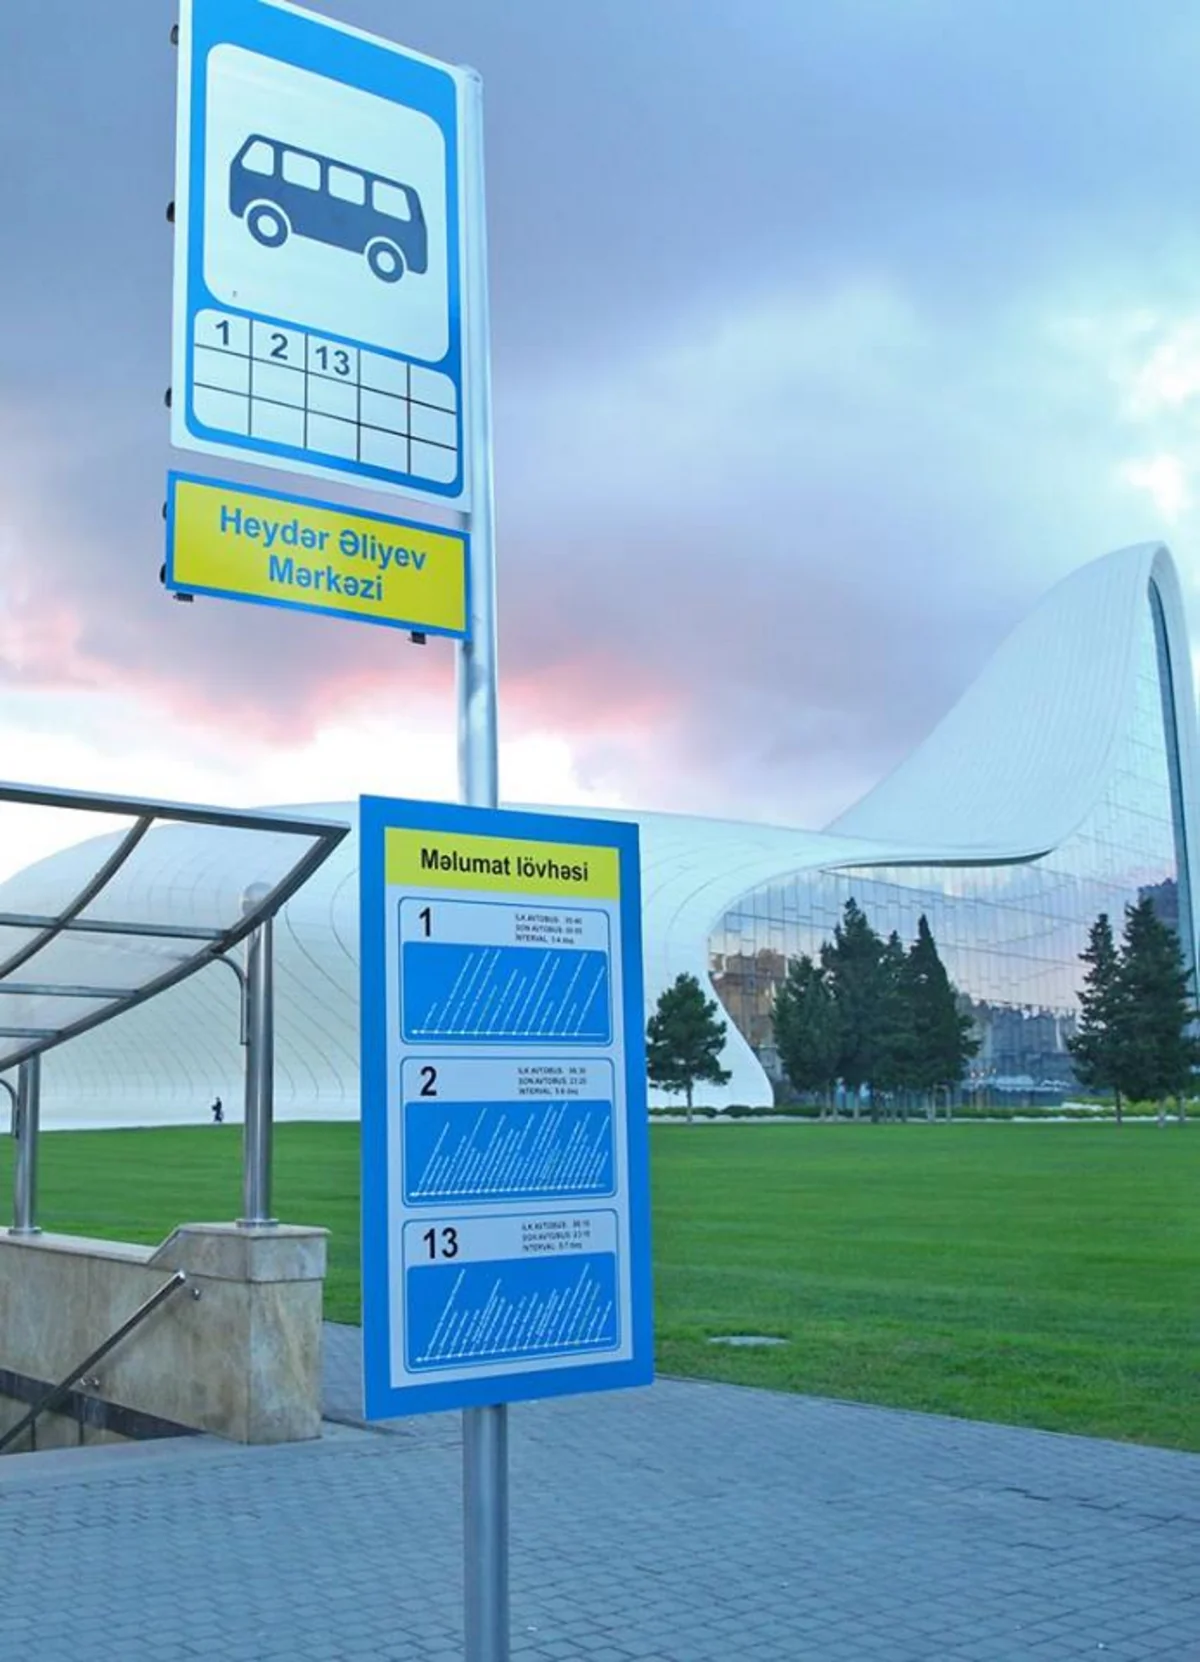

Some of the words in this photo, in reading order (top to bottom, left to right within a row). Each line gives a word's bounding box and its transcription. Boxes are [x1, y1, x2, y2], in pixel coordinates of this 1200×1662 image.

[216, 320, 230, 345] 1
[270, 333, 288, 360] 2
[315, 346, 350, 376] 13
[220, 505, 330, 550] Heydər
[339, 530, 427, 571] Əliyev
[269, 555, 383, 601] Mərkəzi
[421, 848, 511, 876] Məlumat
[517, 856, 588, 881] lövhəsi
[418, 907, 432, 937] 1
[419, 1066, 438, 1097] 2
[423, 1227, 459, 1259] 13
